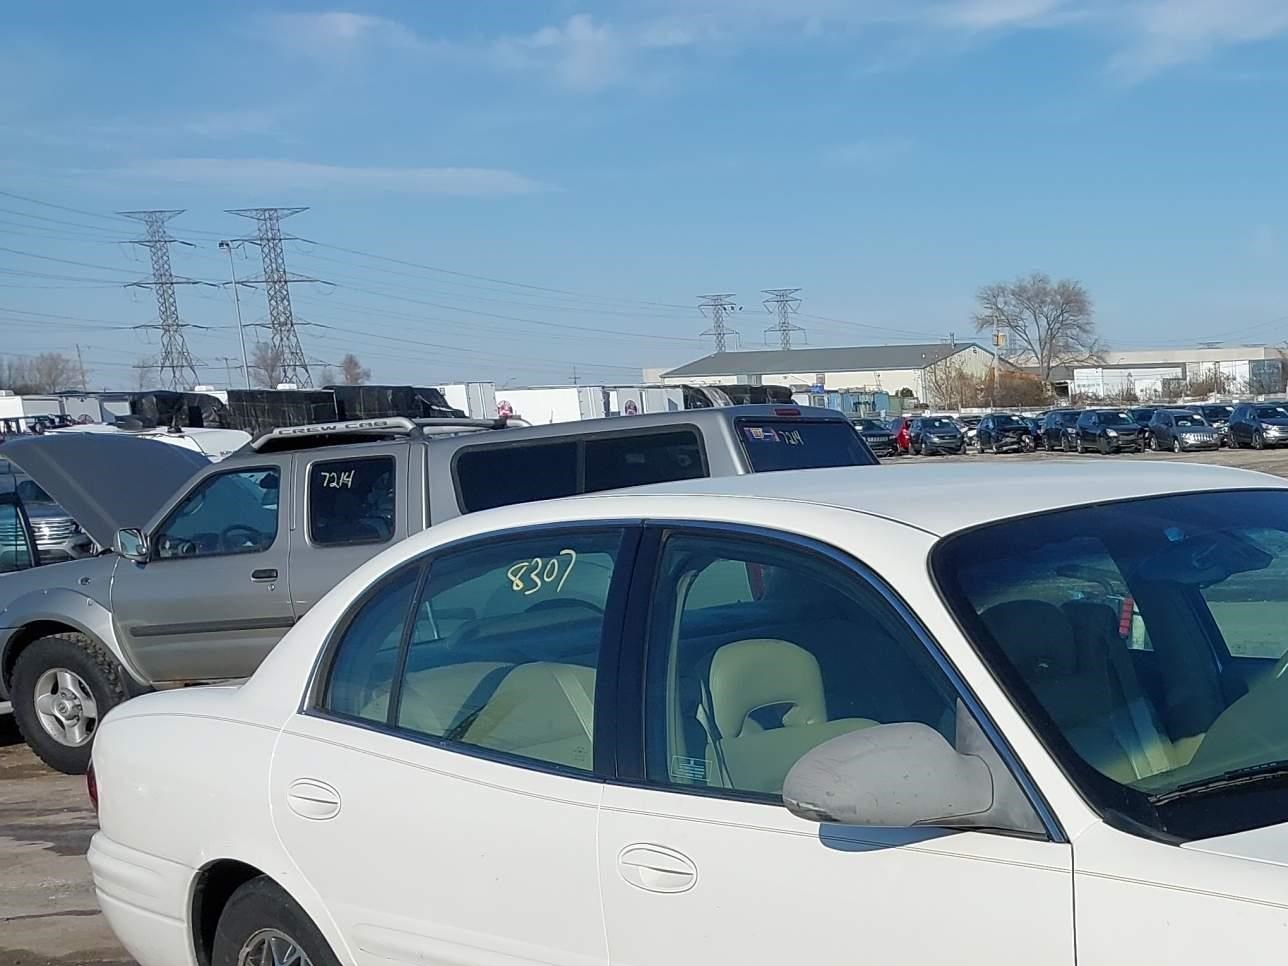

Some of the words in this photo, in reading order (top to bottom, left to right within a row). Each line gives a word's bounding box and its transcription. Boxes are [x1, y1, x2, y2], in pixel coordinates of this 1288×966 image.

[278, 424, 337, 435] CREW
[345, 420, 388, 429] CAB
[778, 429, 804, 445] 7214
[320, 470, 355, 488] 7214
[507, 549, 577, 595] 8307
